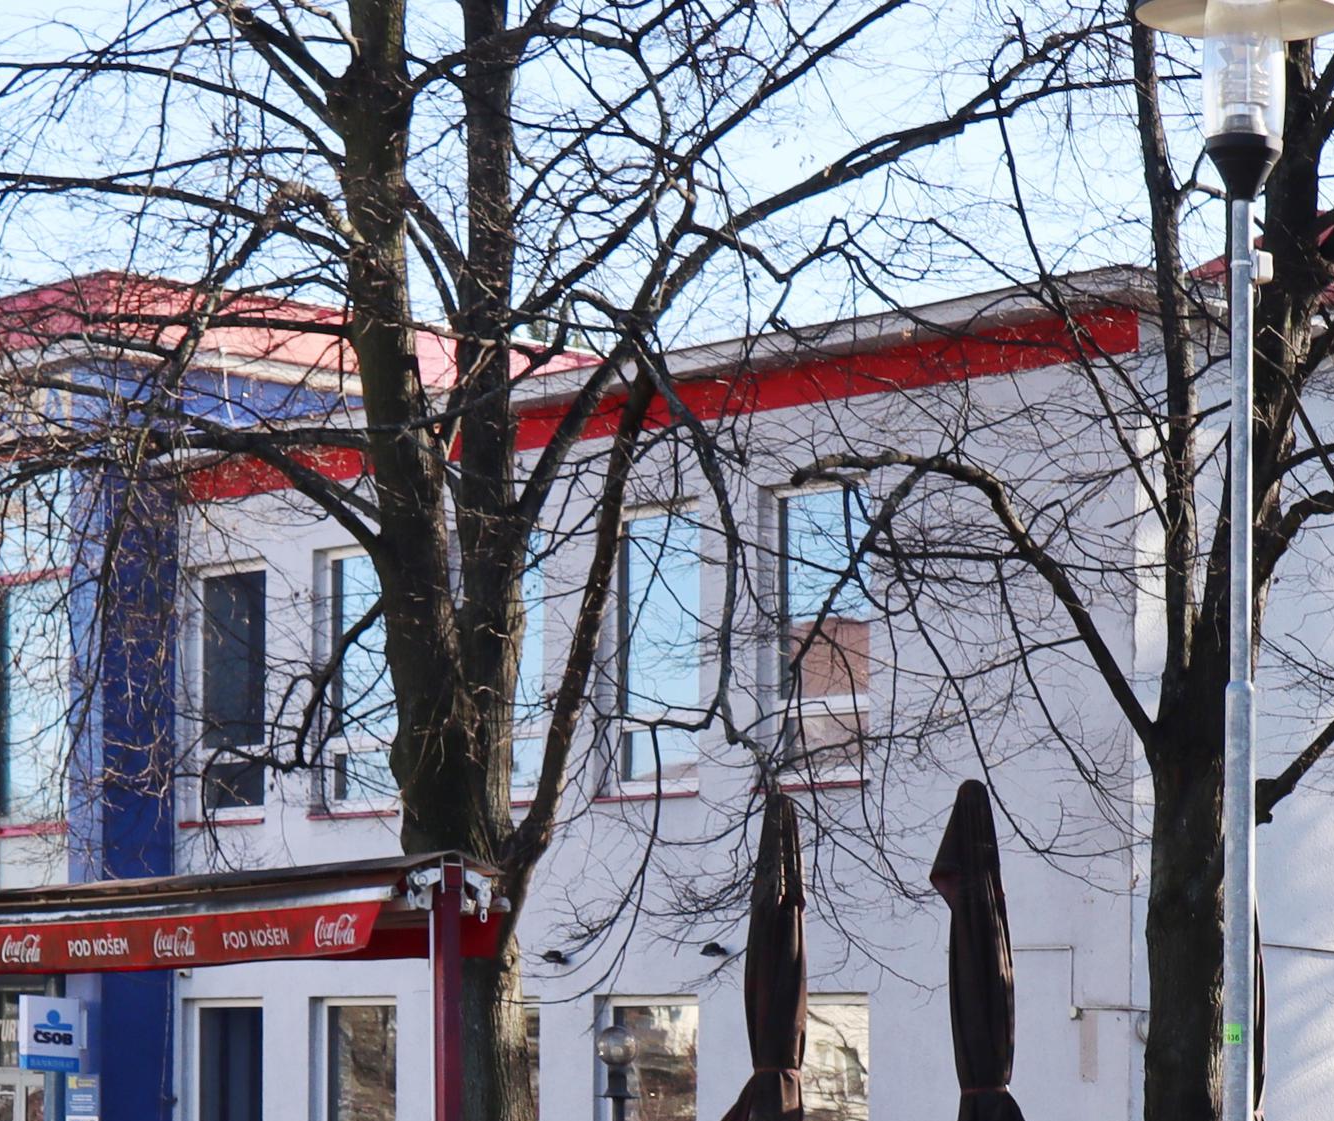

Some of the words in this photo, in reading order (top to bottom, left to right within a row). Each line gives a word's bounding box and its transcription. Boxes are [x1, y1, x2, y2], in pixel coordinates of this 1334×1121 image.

[67, 939, 91, 957] POD
[94, 933, 129, 956] KOŠEM
[223, 931, 248, 950] POD
[251, 924, 290, 947] KOŠEM
[34, 1028, 73, 1046] ČSOB
